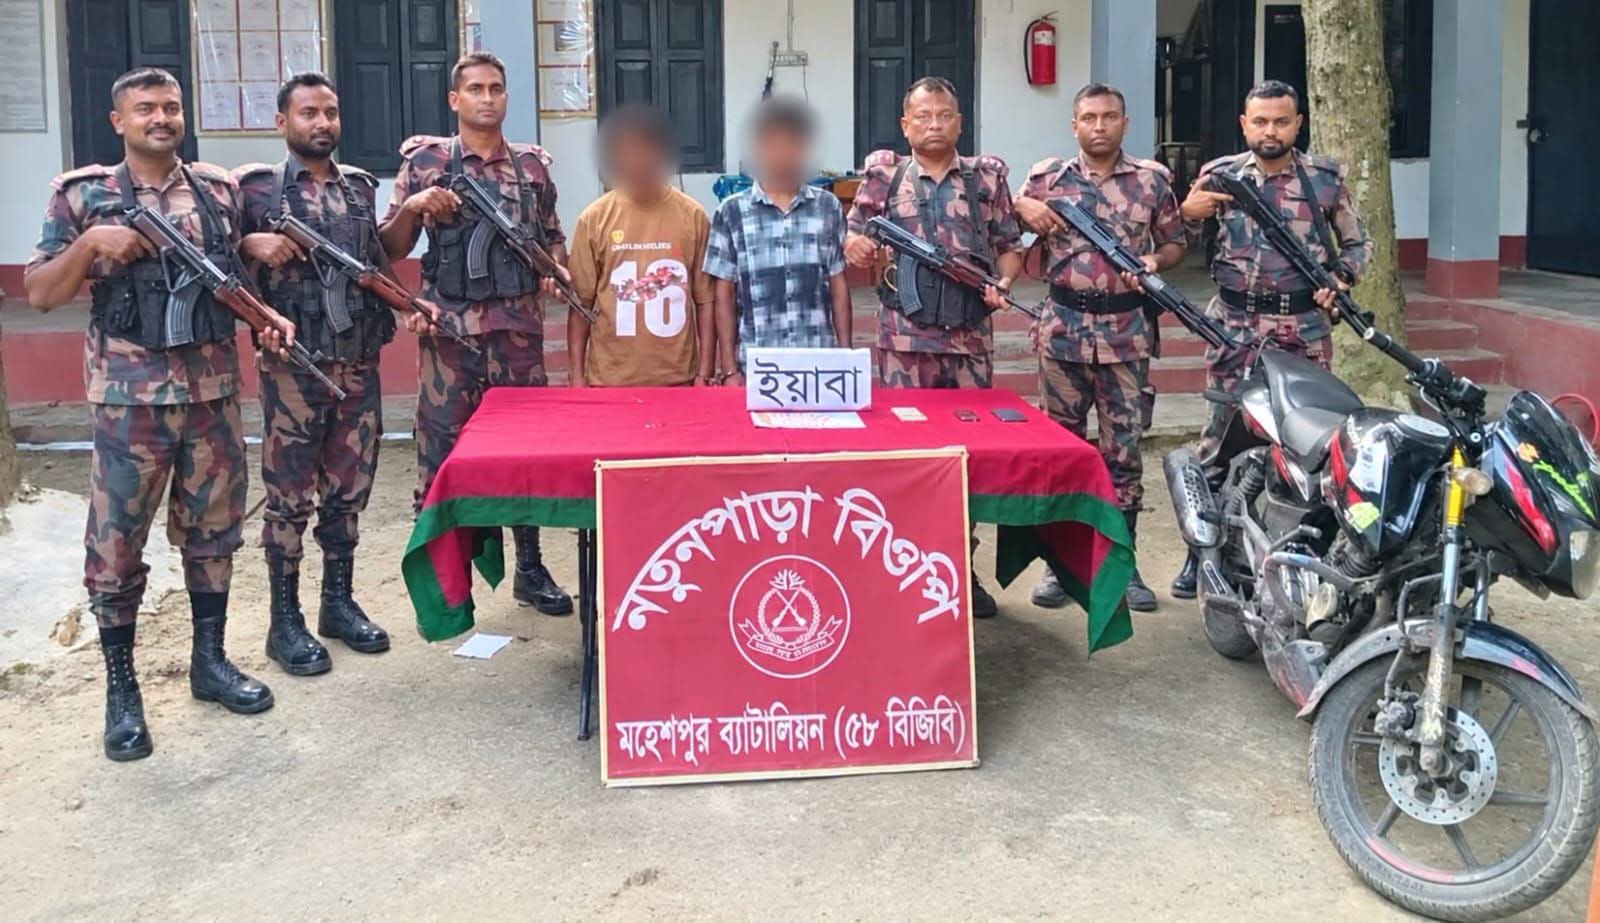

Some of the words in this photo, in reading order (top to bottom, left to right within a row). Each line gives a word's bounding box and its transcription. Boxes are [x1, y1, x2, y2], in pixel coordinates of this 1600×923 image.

[754, 358, 862, 406] ইয়াবা
[612, 485, 824, 632] নতুনপাড়া
[833, 486, 961, 625] বিওপি
[615, 712, 712, 766] মহেশপুর
[717, 701, 827, 755] ব্যাটালিয়ন
[833, 705, 880, 760] (৫৮
[884, 694, 967, 754] বিজিবি)
